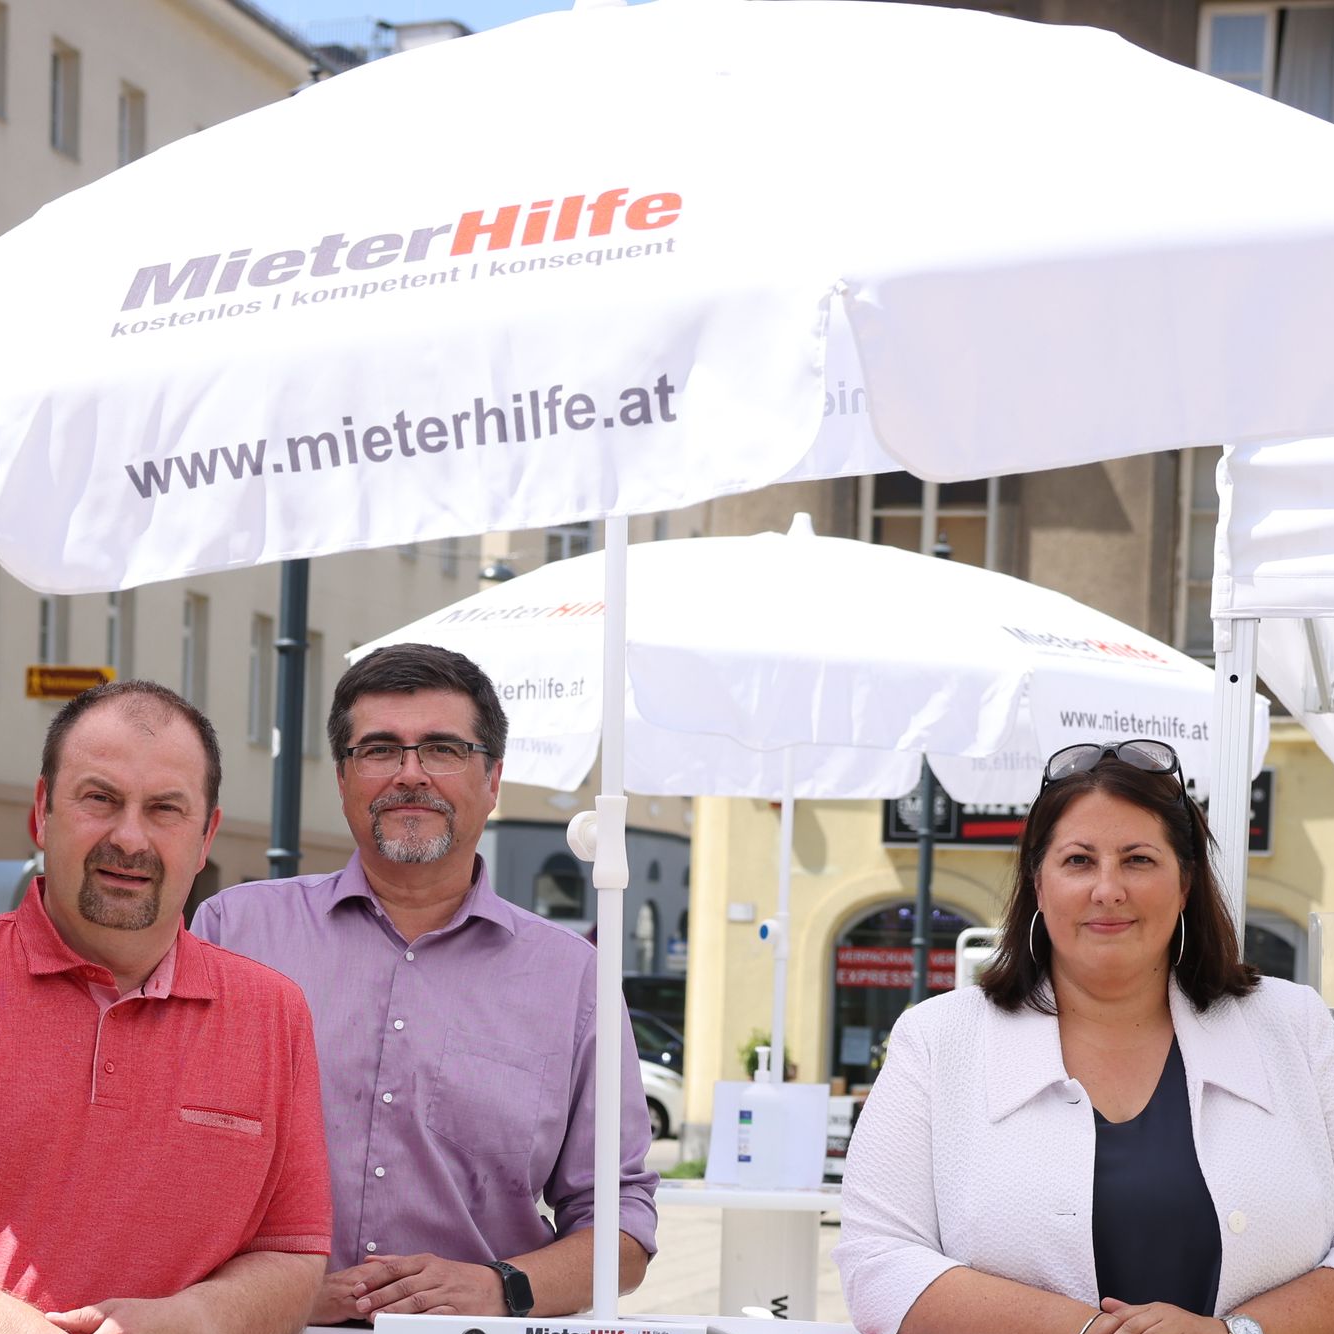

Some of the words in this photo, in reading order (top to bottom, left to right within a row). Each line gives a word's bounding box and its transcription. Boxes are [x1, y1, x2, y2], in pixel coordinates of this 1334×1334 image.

[110, 299, 263, 338] kostenlos
[291, 266, 461, 307] kompetent
[488, 237, 676, 278] konsequent
[120, 187, 683, 312] MieterHilfe
[125, 373, 677, 499] www.mieterhilfe.at
[496, 677, 585, 701] terhilfe.at
[1060, 709, 1209, 741] www.mieterhilfe.at
